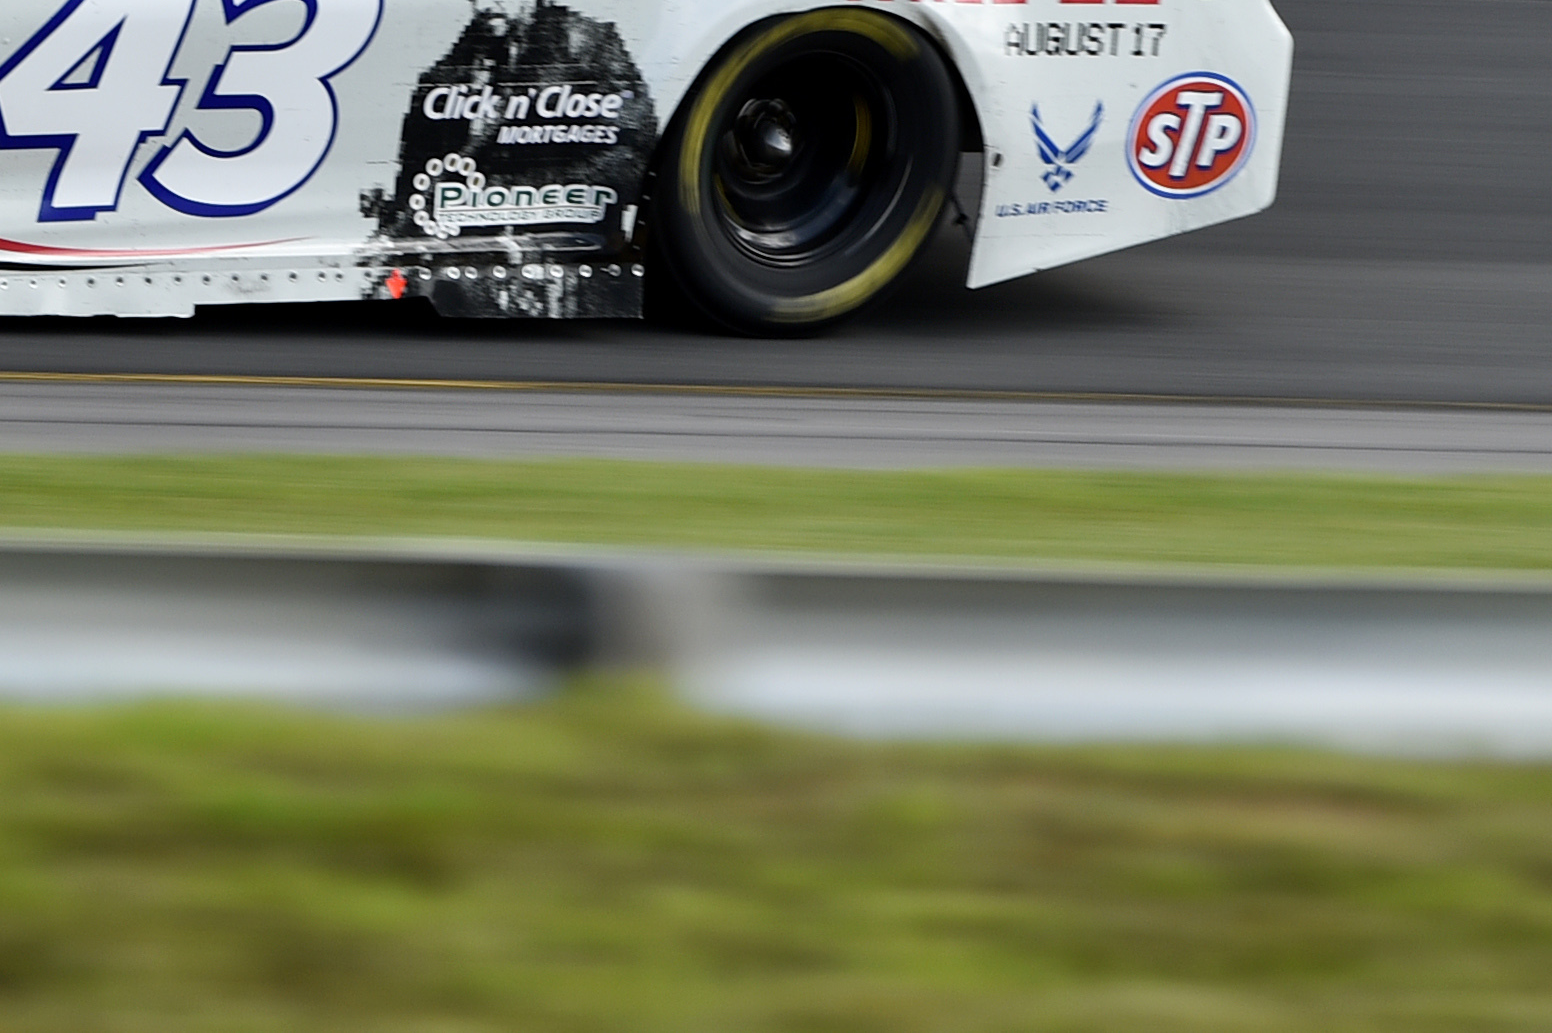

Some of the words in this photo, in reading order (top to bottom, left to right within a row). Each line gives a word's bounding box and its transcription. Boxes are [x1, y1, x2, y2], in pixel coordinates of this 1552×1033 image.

[1004, 23, 1125, 56] AUGUST
[1130, 23, 1167, 56] 17
[423, 86, 501, 120] Click
[535, 85, 624, 118] Close
[497, 124, 621, 144] MORTGAGES
[1138, 91, 1242, 179] STP
[1025, 202, 1048, 215] AIR
[1052, 200, 1108, 214] FORCE
